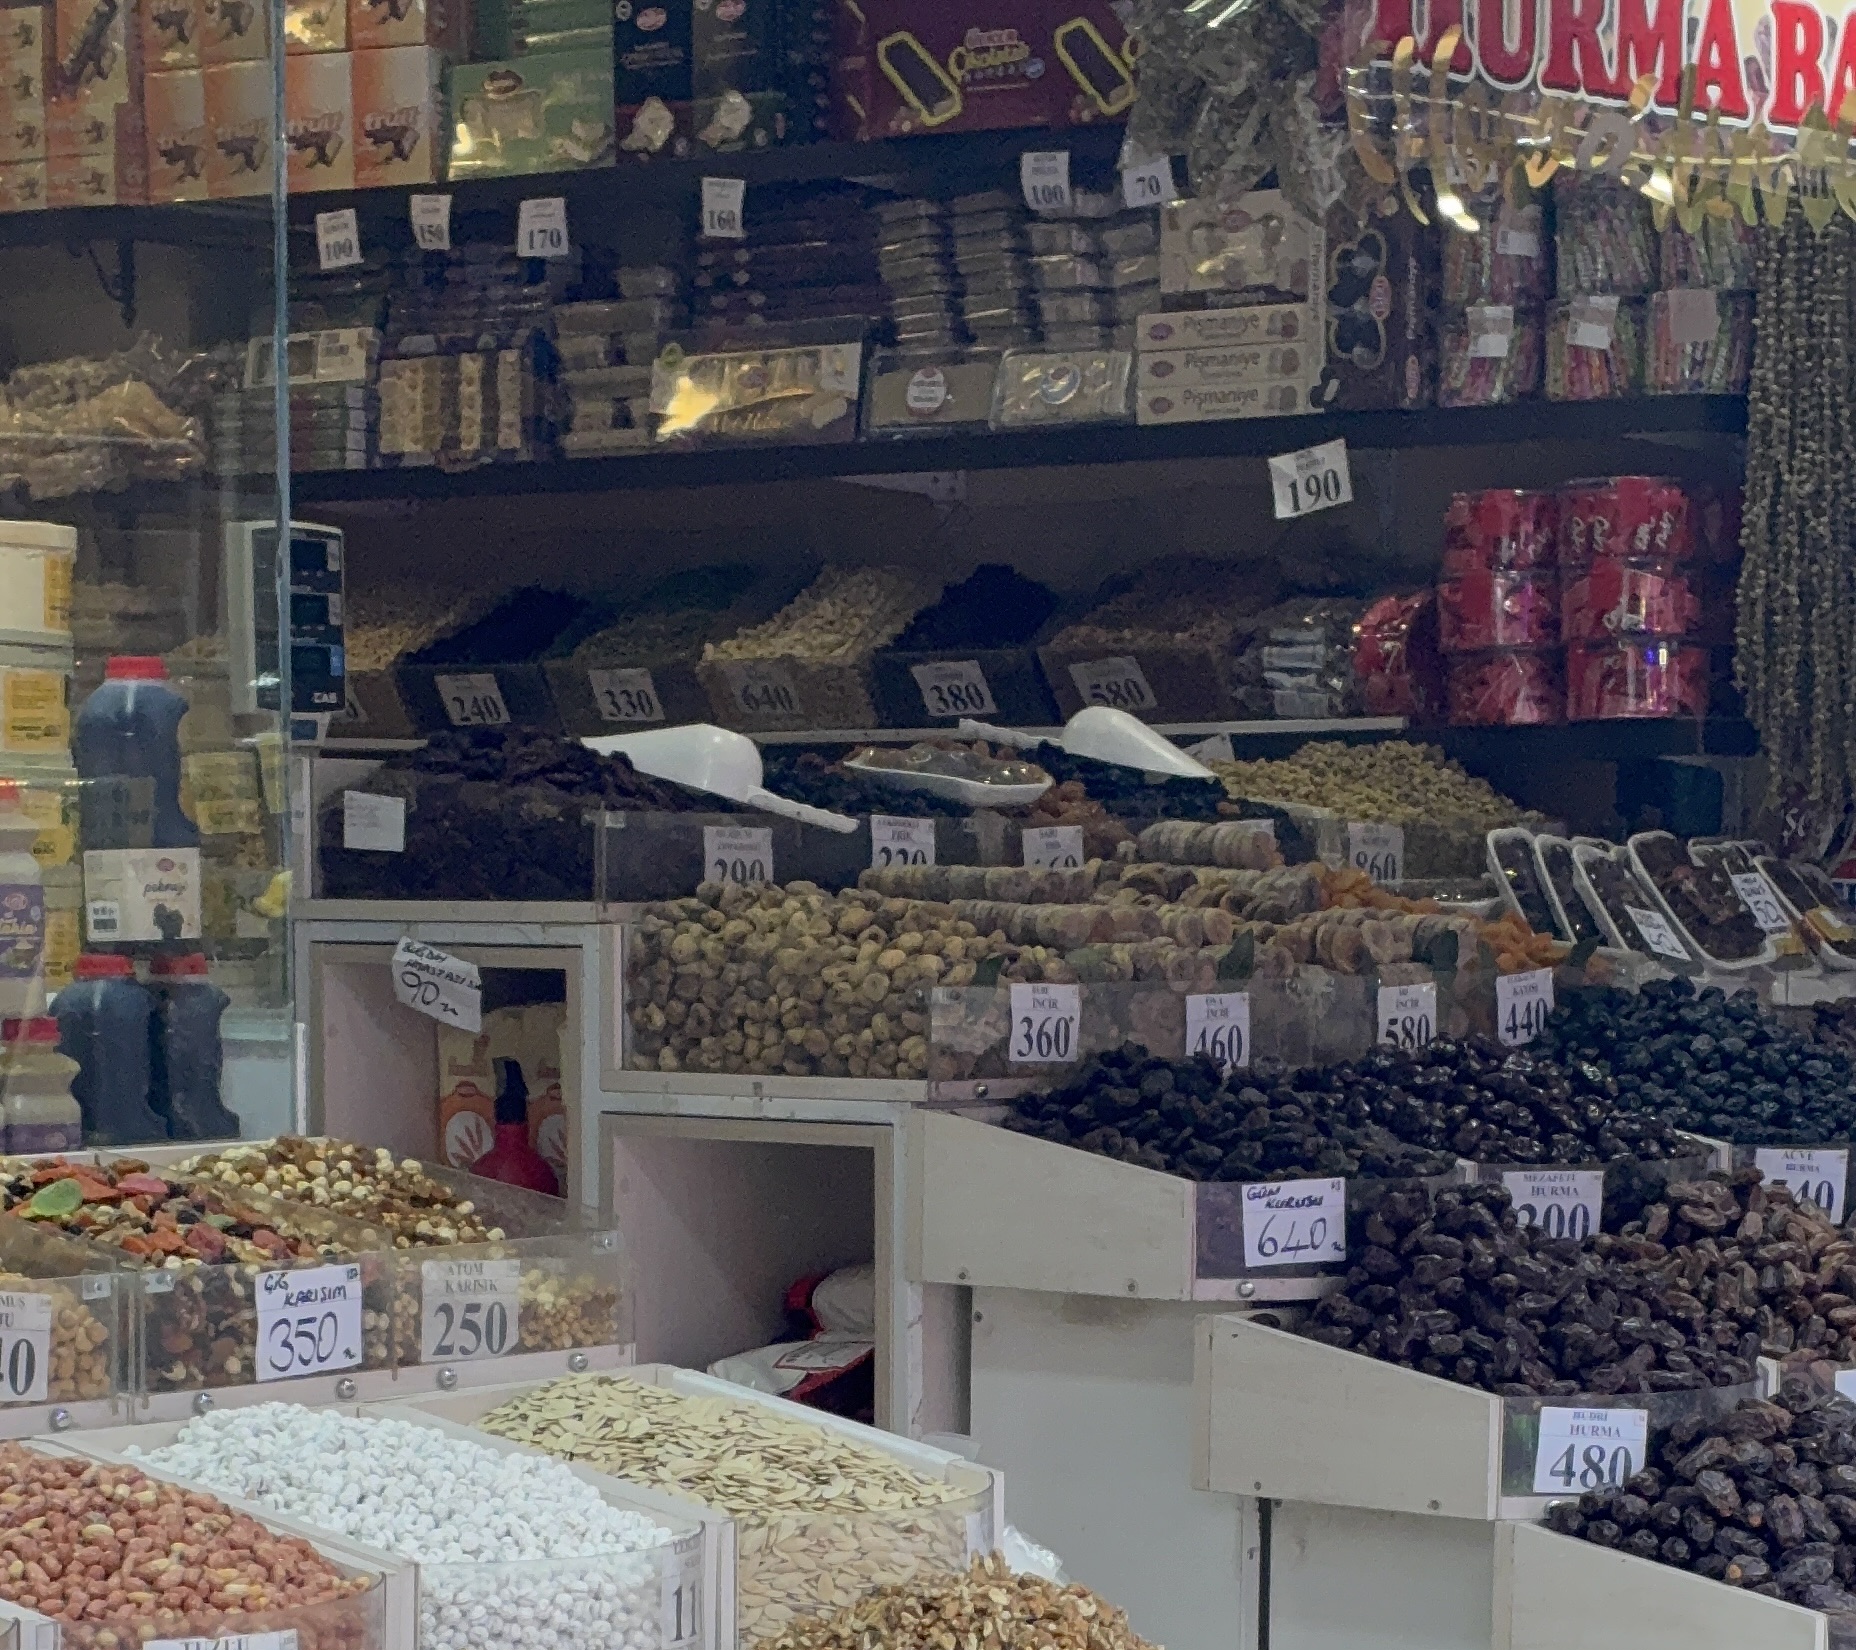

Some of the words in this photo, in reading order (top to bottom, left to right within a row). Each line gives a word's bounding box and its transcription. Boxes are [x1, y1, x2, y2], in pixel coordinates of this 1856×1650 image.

[529, 228, 562, 251] 170
[1288, 469, 1341, 513] 190
[452, 695, 503, 723] 240
[603, 689, 655, 718] 330
[930, 681, 985, 713] 380
[1089, 677, 1146, 706] 580
[1017, 1016, 1070, 1058] 360
[1385, 1013, 1430, 1050] 580
[1505, 997, 1547, 1040] 440
[1194, 1024, 1243, 1066] 460
[1531, 1185, 1579, 1197] HURMA
[1257, 1213, 1327, 1259] 640
[447, 1262, 484, 1276] ATOM
[269, 1312, 339, 1372] 350
[433, 1300, 509, 1357] 250
[0, 1336, 37, 1397] 0
[1570, 1424, 1621, 1438] HURMA
[1549, 1443, 1633, 1490] 480
